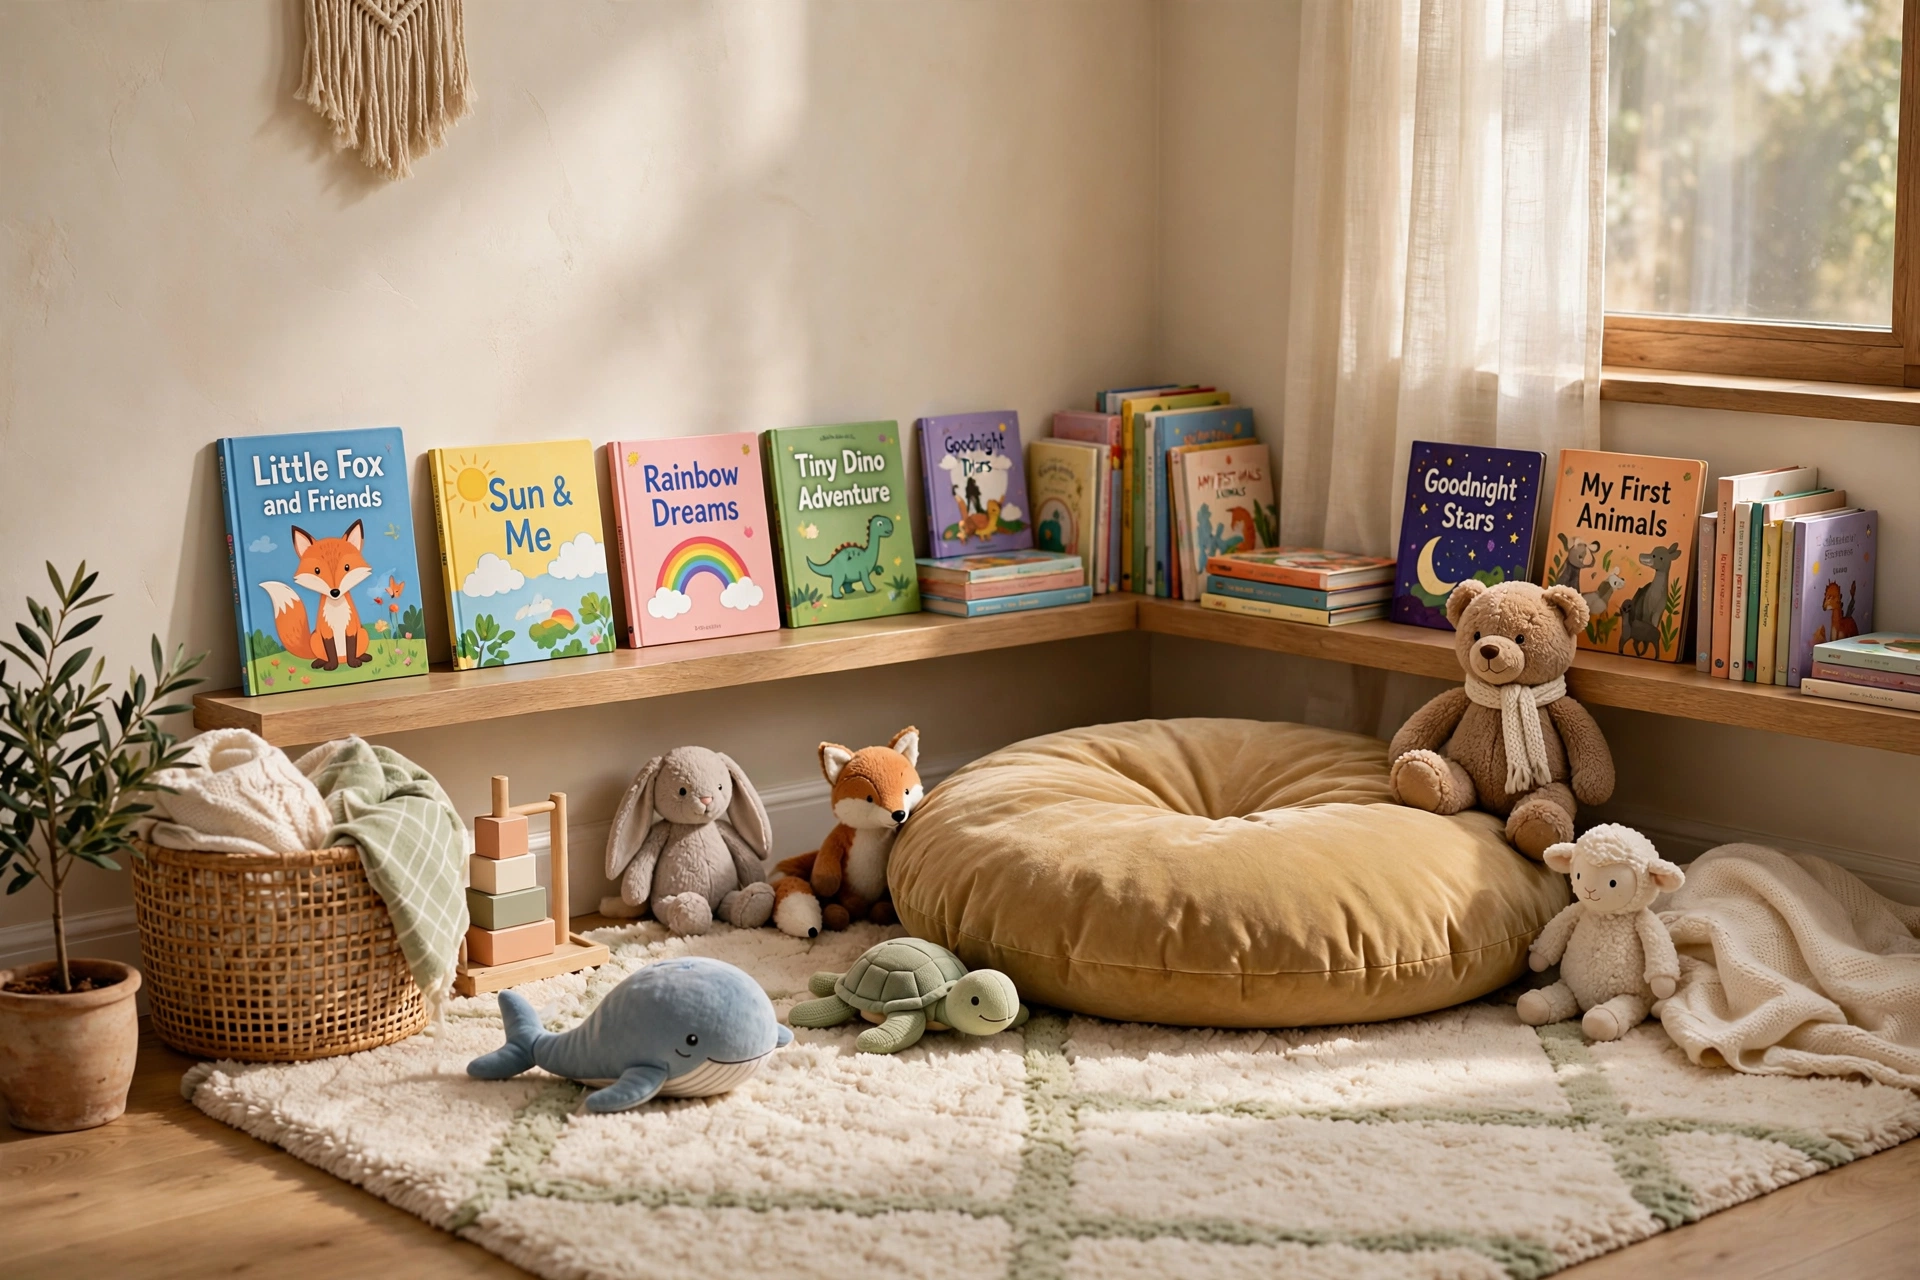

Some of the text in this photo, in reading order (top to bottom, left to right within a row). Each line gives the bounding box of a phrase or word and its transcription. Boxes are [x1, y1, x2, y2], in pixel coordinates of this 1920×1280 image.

[944, 431, 1006, 456] Goodnight
[253, 451, 329, 486] Little
[337, 449, 385, 479] Fox
[643, 461, 739, 493] Rainbow
[794, 449, 885, 482] Tiny Dino
[263, 485, 382, 516] and Friends
[489, 475, 573, 512] Sun &
[798, 483, 891, 511] Adventure
[1424, 468, 1518, 507] Goodnight
[1580, 471, 1672, 505] My First
[651, 498, 739, 527] Dreams
[1441, 502, 1495, 532] Stars
[1576, 502, 1668, 538] Animals
[505, 518, 552, 555] Me
